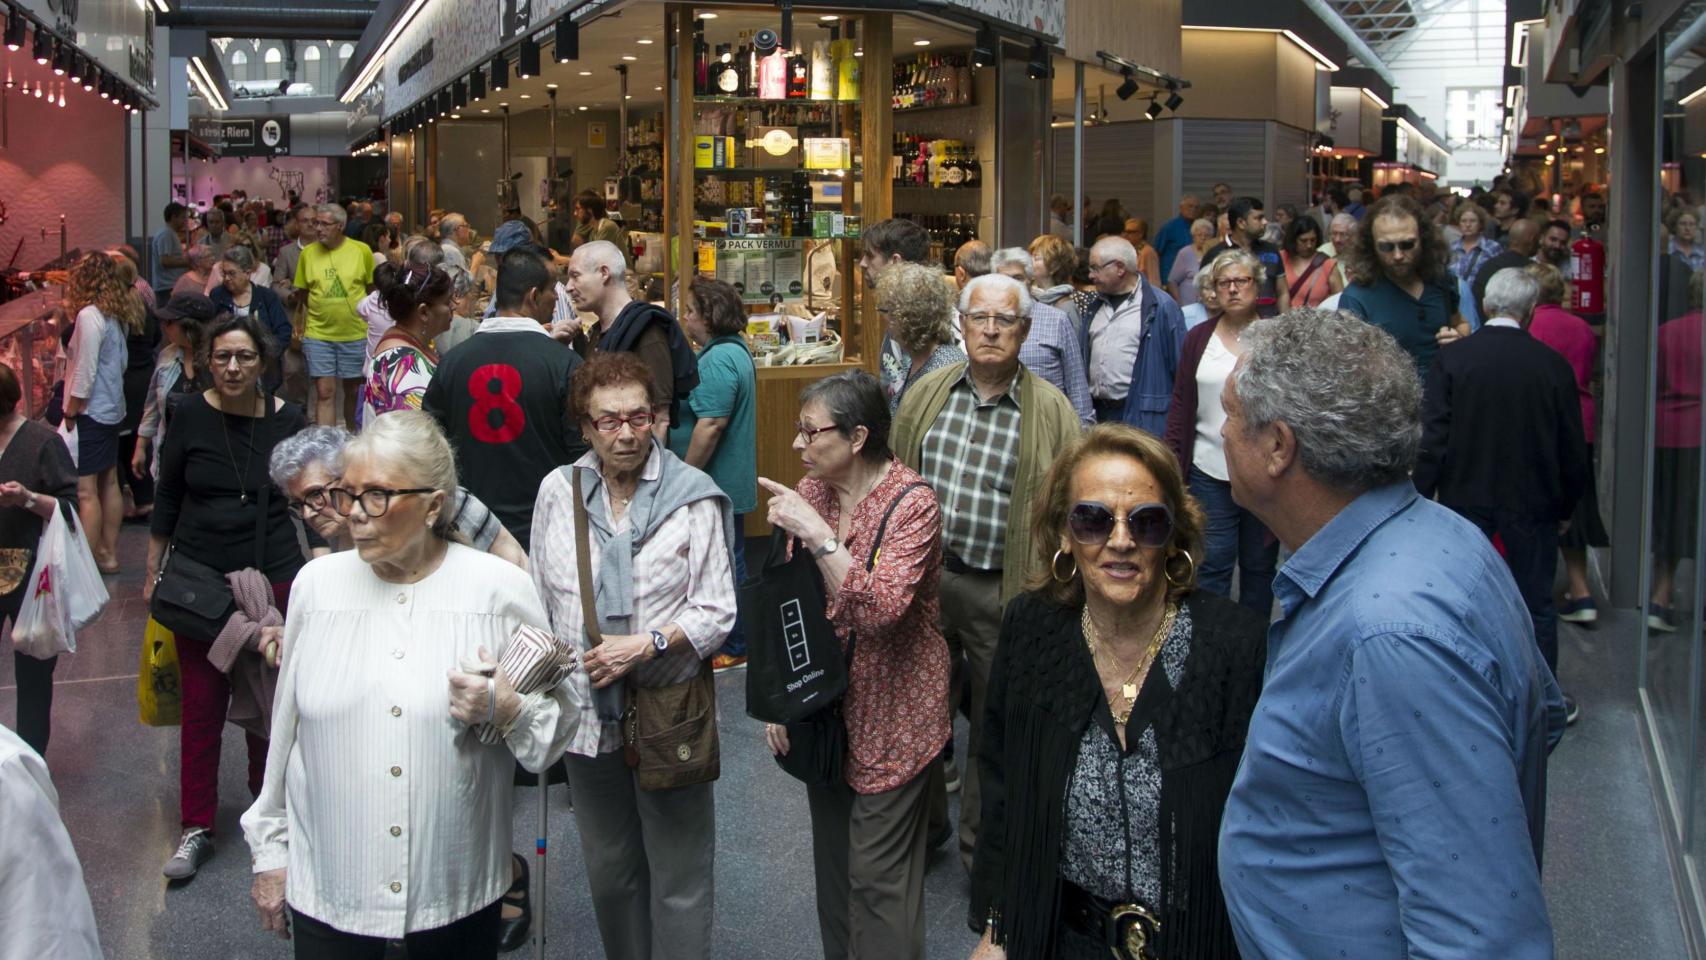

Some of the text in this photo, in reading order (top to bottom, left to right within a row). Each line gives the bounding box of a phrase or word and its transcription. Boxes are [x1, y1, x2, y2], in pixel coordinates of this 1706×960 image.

[227, 126, 249, 138] Riera
[728, 240, 796, 249] PACK VERMUT
[469, 364, 525, 443] 8
[786, 669, 825, 692] Shop Online
